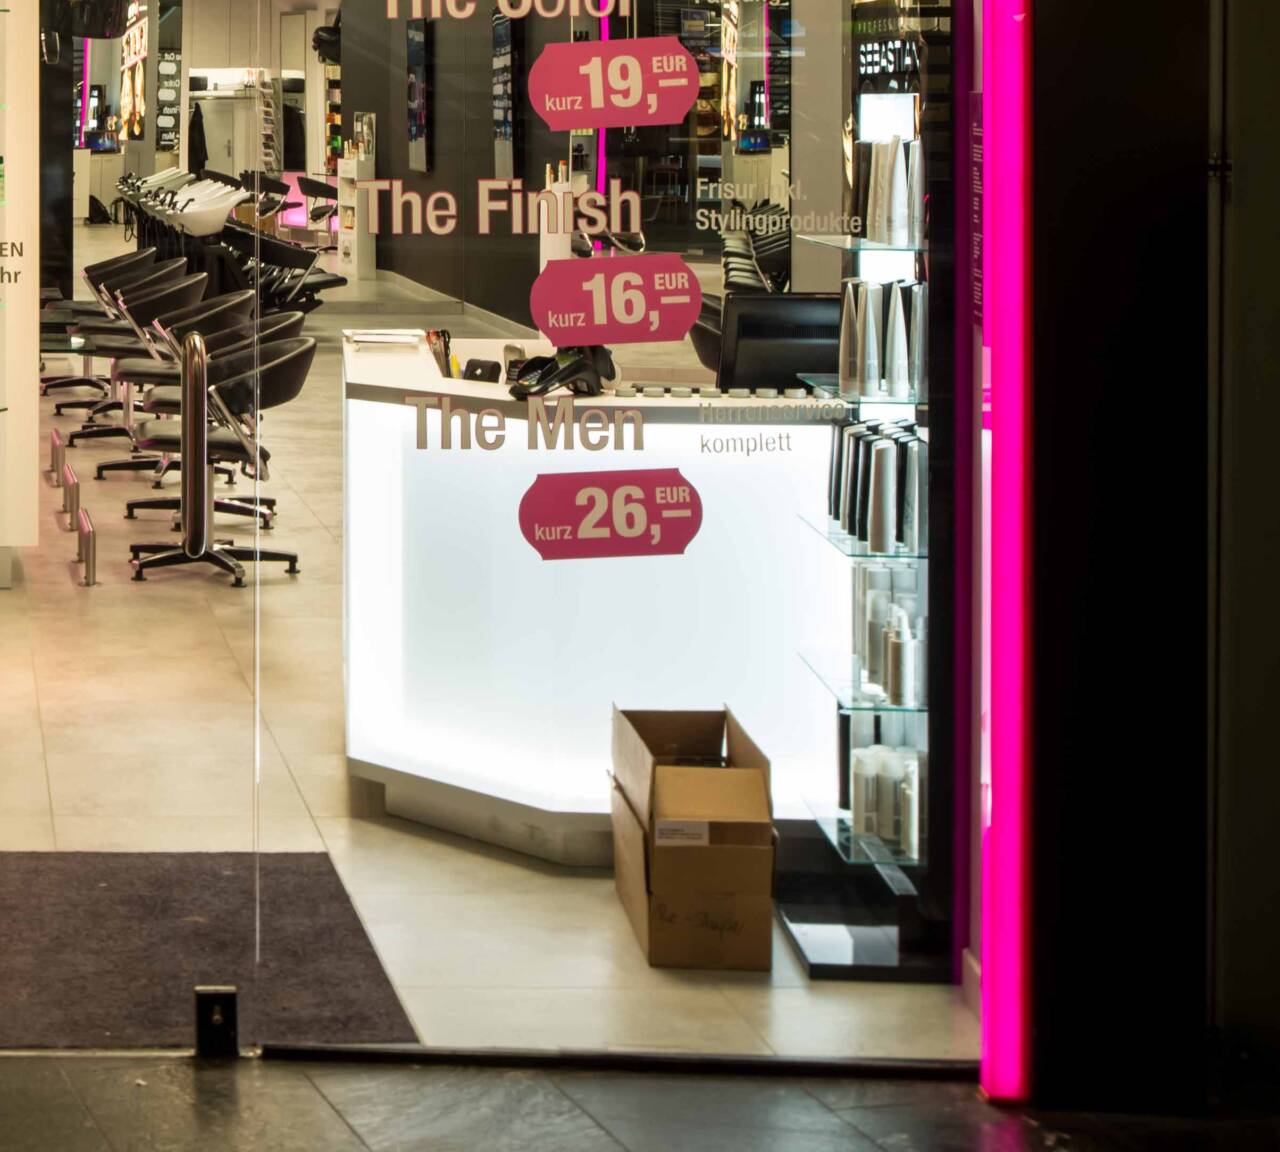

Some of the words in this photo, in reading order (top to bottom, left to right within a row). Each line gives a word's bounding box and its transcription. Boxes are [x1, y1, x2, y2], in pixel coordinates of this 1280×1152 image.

[544, 92, 583, 113] kurz
[651, 54, 688, 74] EUR
[355, 179, 457, 235] The
[477, 177, 642, 236] Finish
[695, 178, 755, 201] Frisur
[695, 207, 863, 235] Stylingprodukte
[547, 309, 586, 329] kurz
[654, 272, 689, 291] EUR
[405, 396, 506, 451] The
[526, 396, 645, 451] Men
[700, 431, 793, 457] komplett
[533, 523, 573, 542] kurz
[654, 486, 691, 505] EUR
